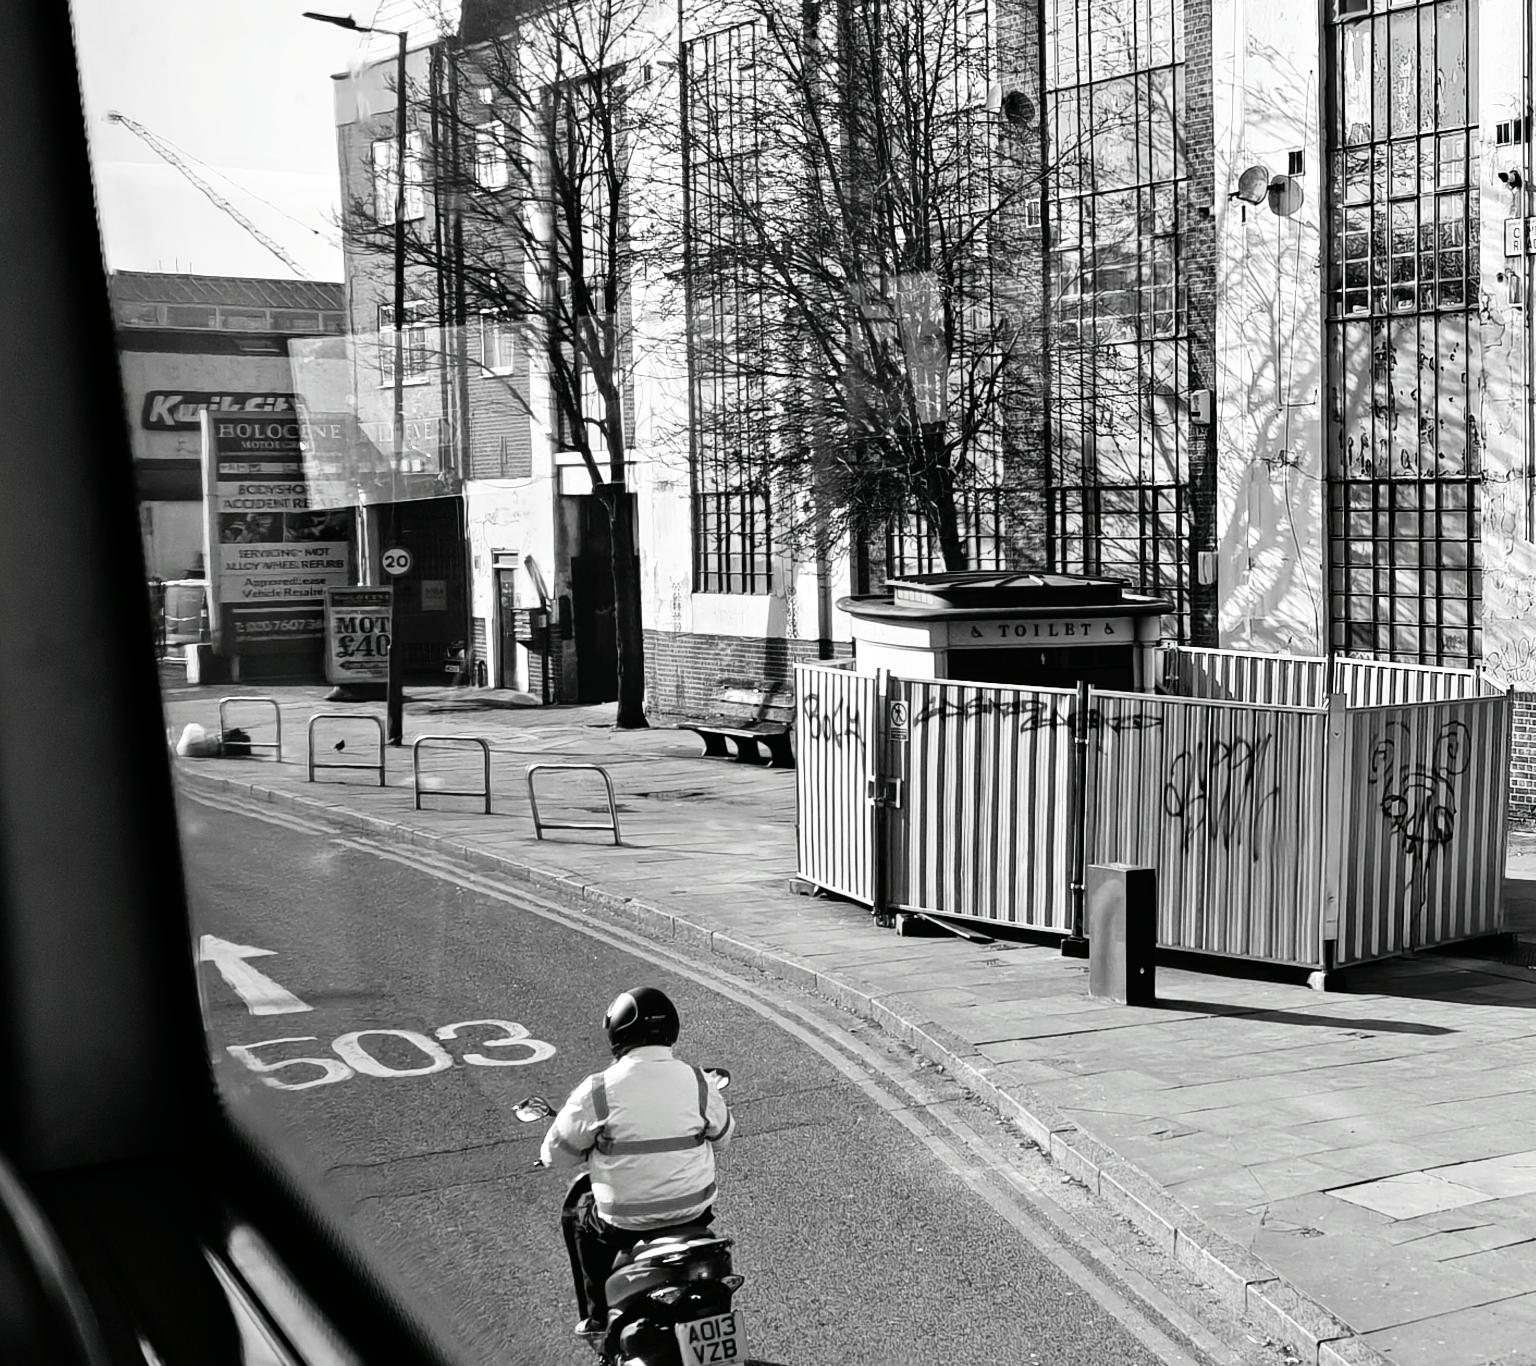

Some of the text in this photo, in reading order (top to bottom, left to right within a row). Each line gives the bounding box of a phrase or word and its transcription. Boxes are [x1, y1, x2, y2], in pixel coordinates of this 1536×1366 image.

[218, 423, 343, 439] HOLOCENE
[384, 555, 409, 569] 20
[334, 616, 391, 634] MOT
[998, 622, 1091, 638] TOILET
[335, 633, 391, 659] £40
[689, 1316, 737, 1345] AO13
[692, 1337, 738, 1365] VZB
